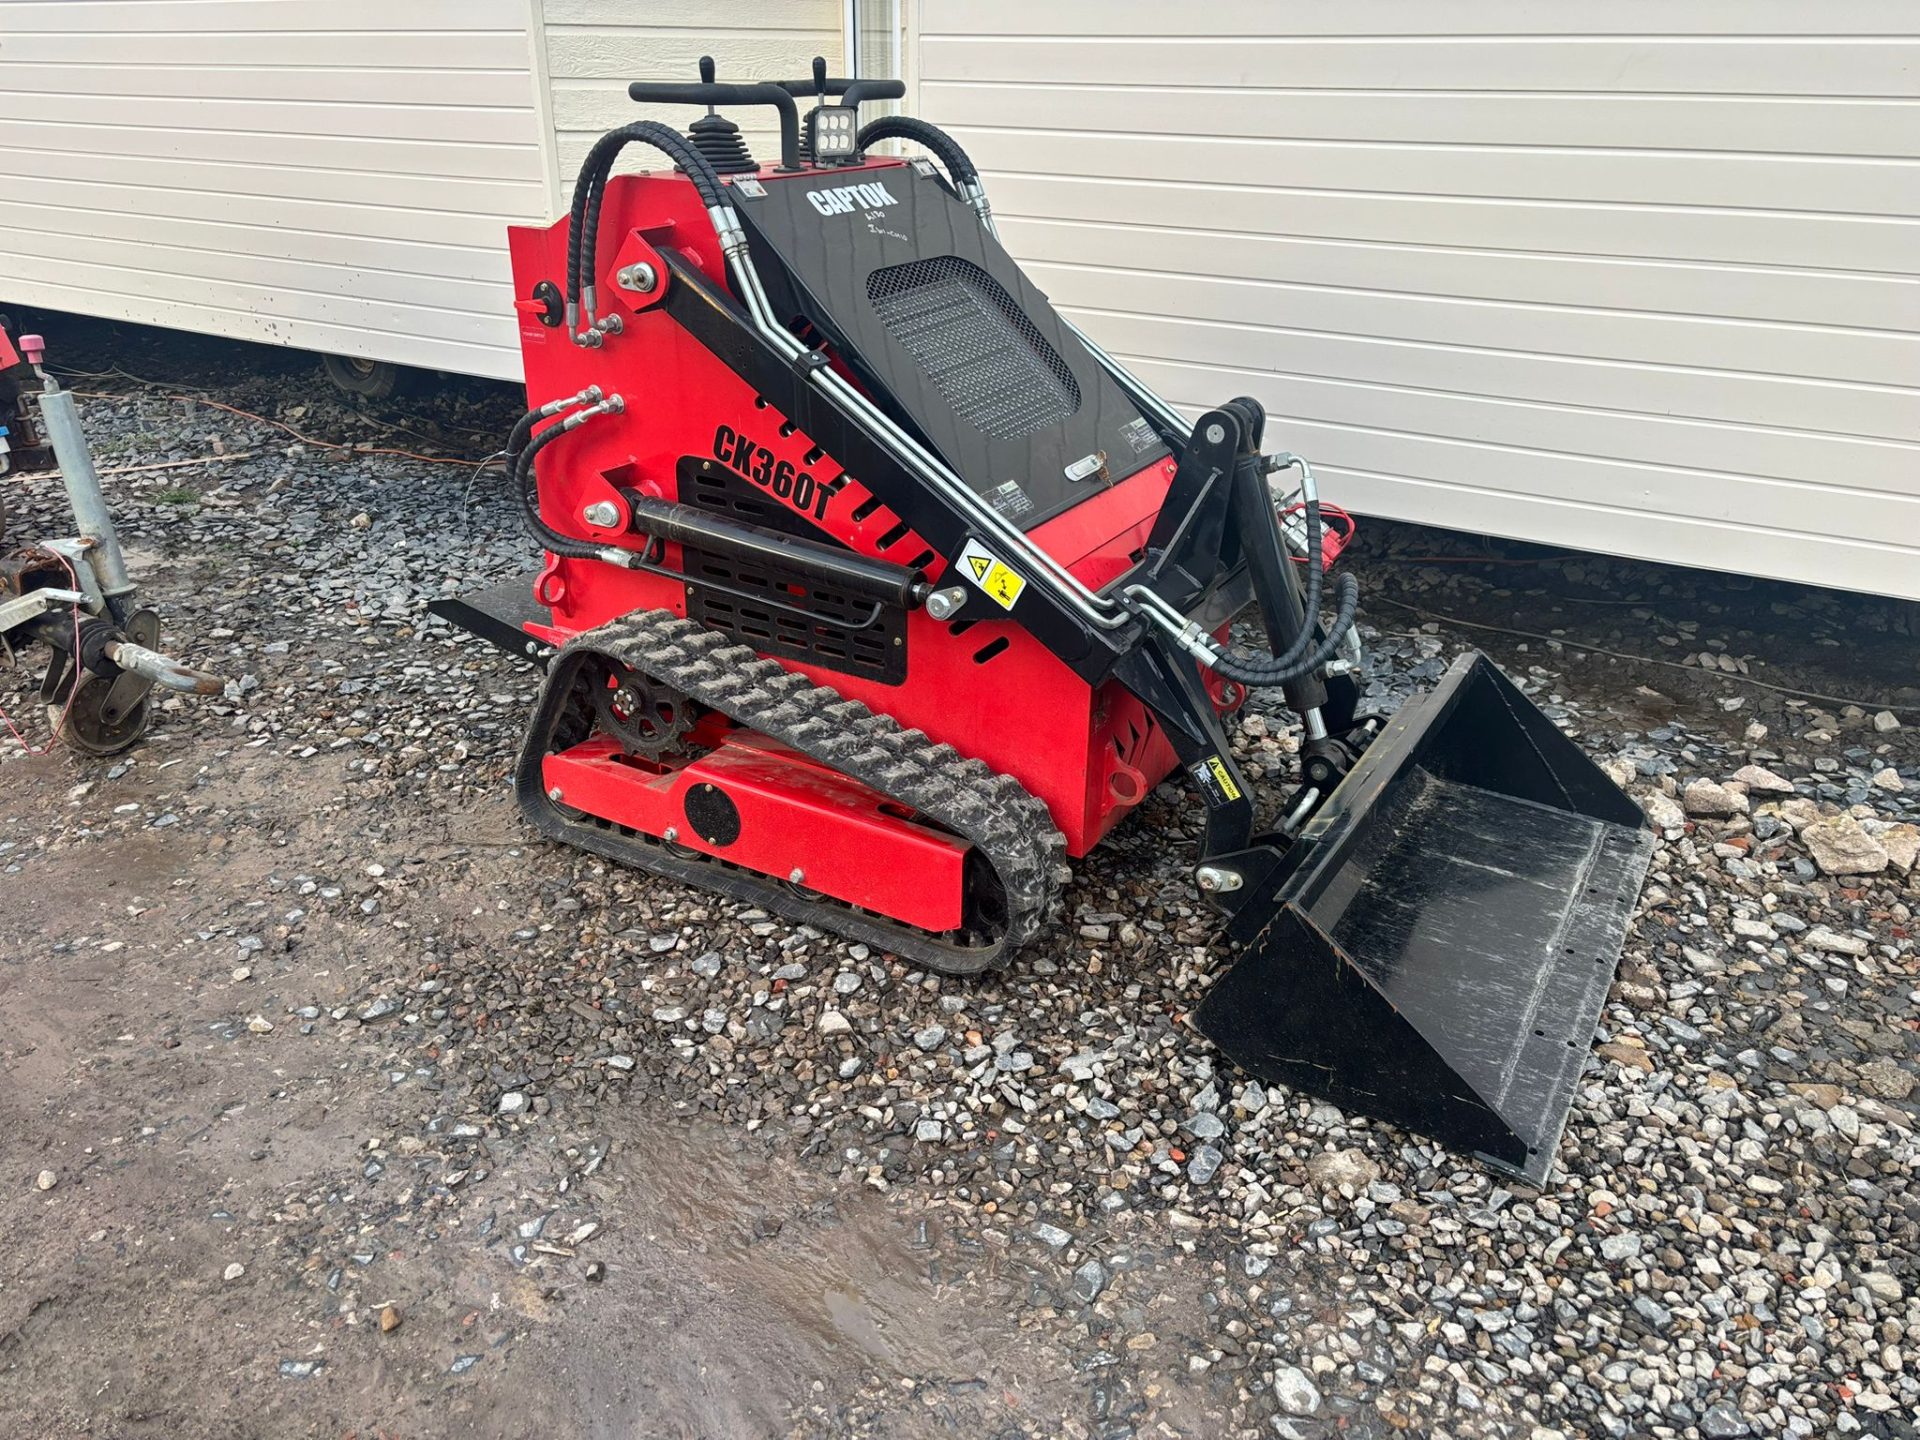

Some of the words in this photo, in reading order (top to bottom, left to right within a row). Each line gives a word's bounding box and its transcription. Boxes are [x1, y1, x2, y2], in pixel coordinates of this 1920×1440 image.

[806, 182, 899, 217] CAPTOK
[713, 424, 836, 521] CK360T
[1217, 770, 1237, 799] CAUTION
